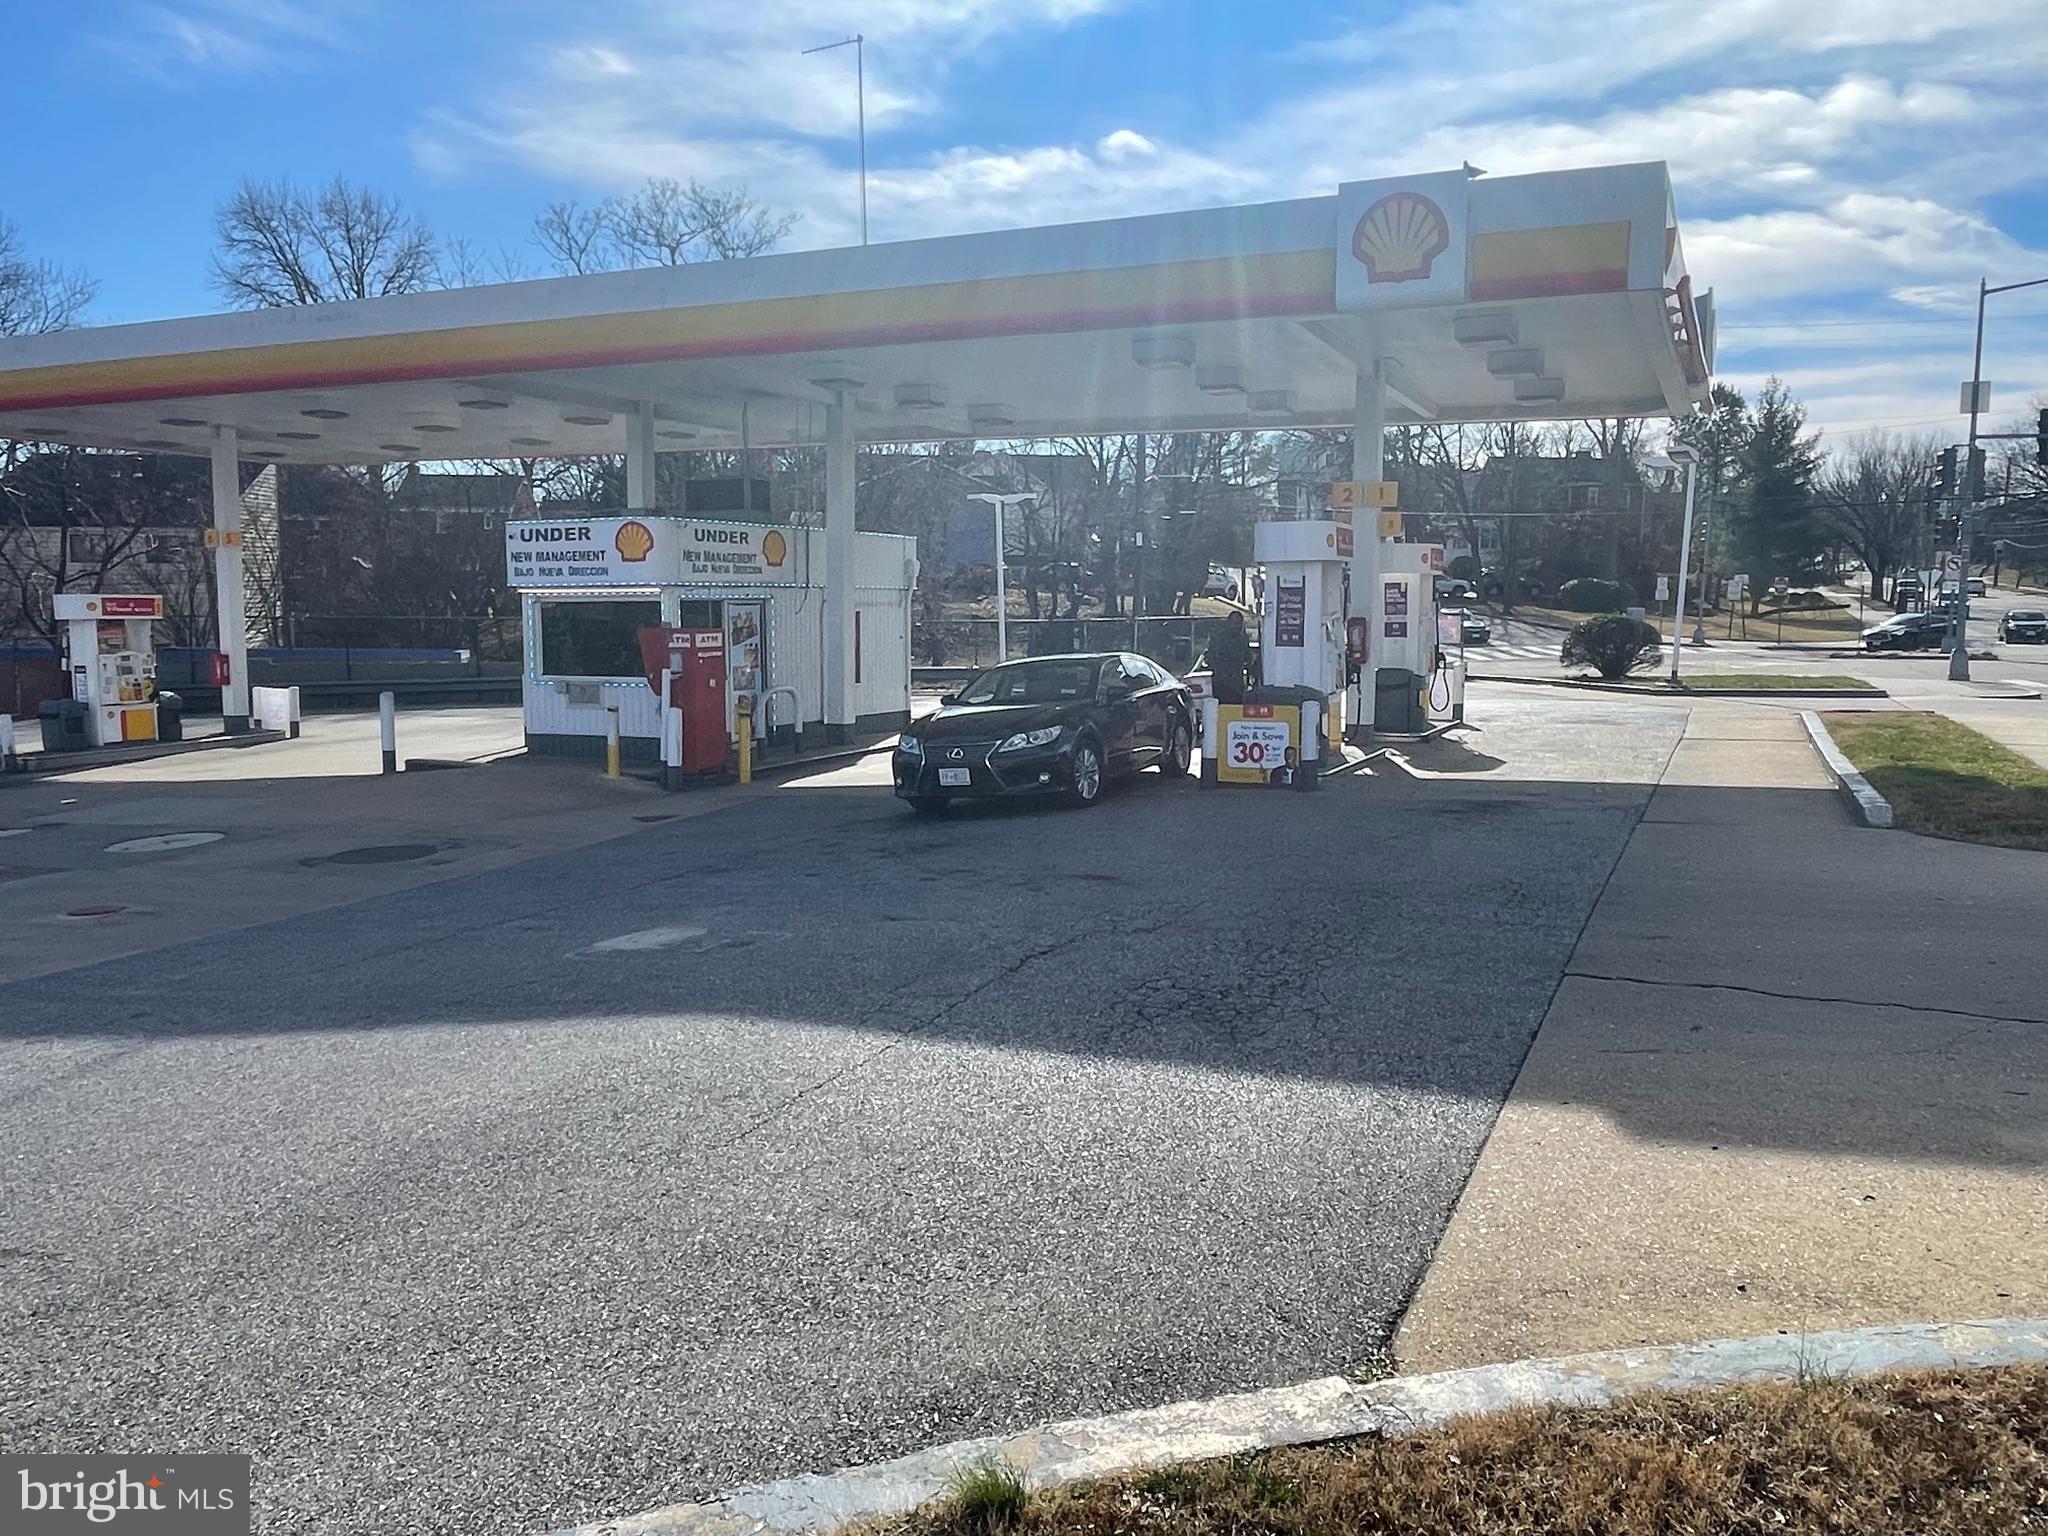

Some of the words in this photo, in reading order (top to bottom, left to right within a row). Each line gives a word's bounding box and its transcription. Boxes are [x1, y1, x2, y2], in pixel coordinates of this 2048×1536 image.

[1342, 487, 1354, 502] 2
[1378, 487, 1385, 500] 1
[520, 526, 592, 543] UNDER
[694, 528, 750, 545] UNDER
[510, 551, 533, 563] NEW
[535, 550, 607, 562] MANAGEMENT
[700, 635, 719, 643] ATM
[1232, 731, 1250, 740] Join
[1252, 731, 1259, 740] &
[1261, 731, 1285, 741] Save
